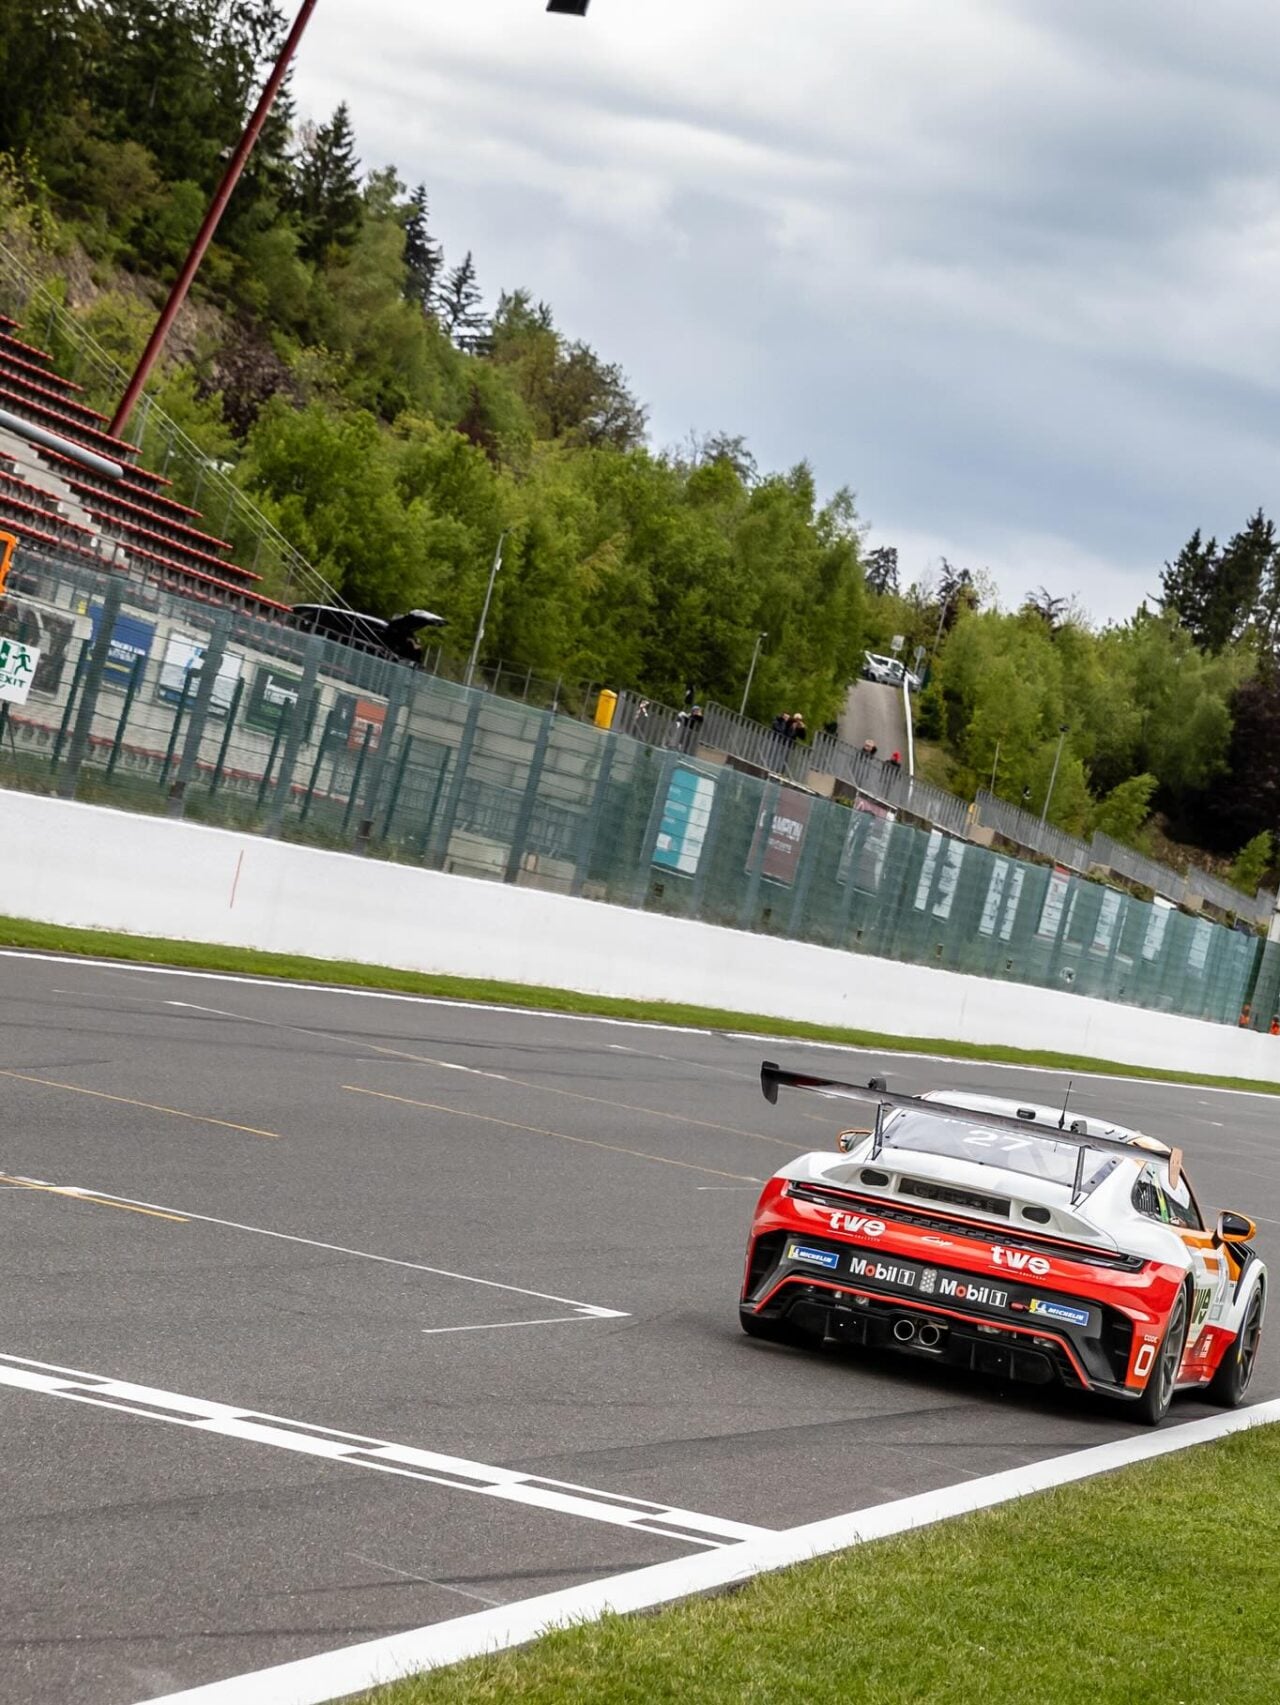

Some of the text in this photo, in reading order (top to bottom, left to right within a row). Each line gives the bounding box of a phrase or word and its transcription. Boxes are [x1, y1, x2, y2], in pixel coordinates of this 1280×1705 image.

[0, 674, 26, 688] EXIT
[962, 1129, 1034, 1152] 27
[829, 1211, 886, 1237] twe
[799, 1251, 833, 1263] MICHELIN
[990, 1245, 1050, 1275] twe
[849, 1257, 898, 1283] Mobil
[939, 1278, 989, 1304] Mobil
[1048, 1307, 1084, 1321] MICHELIN
